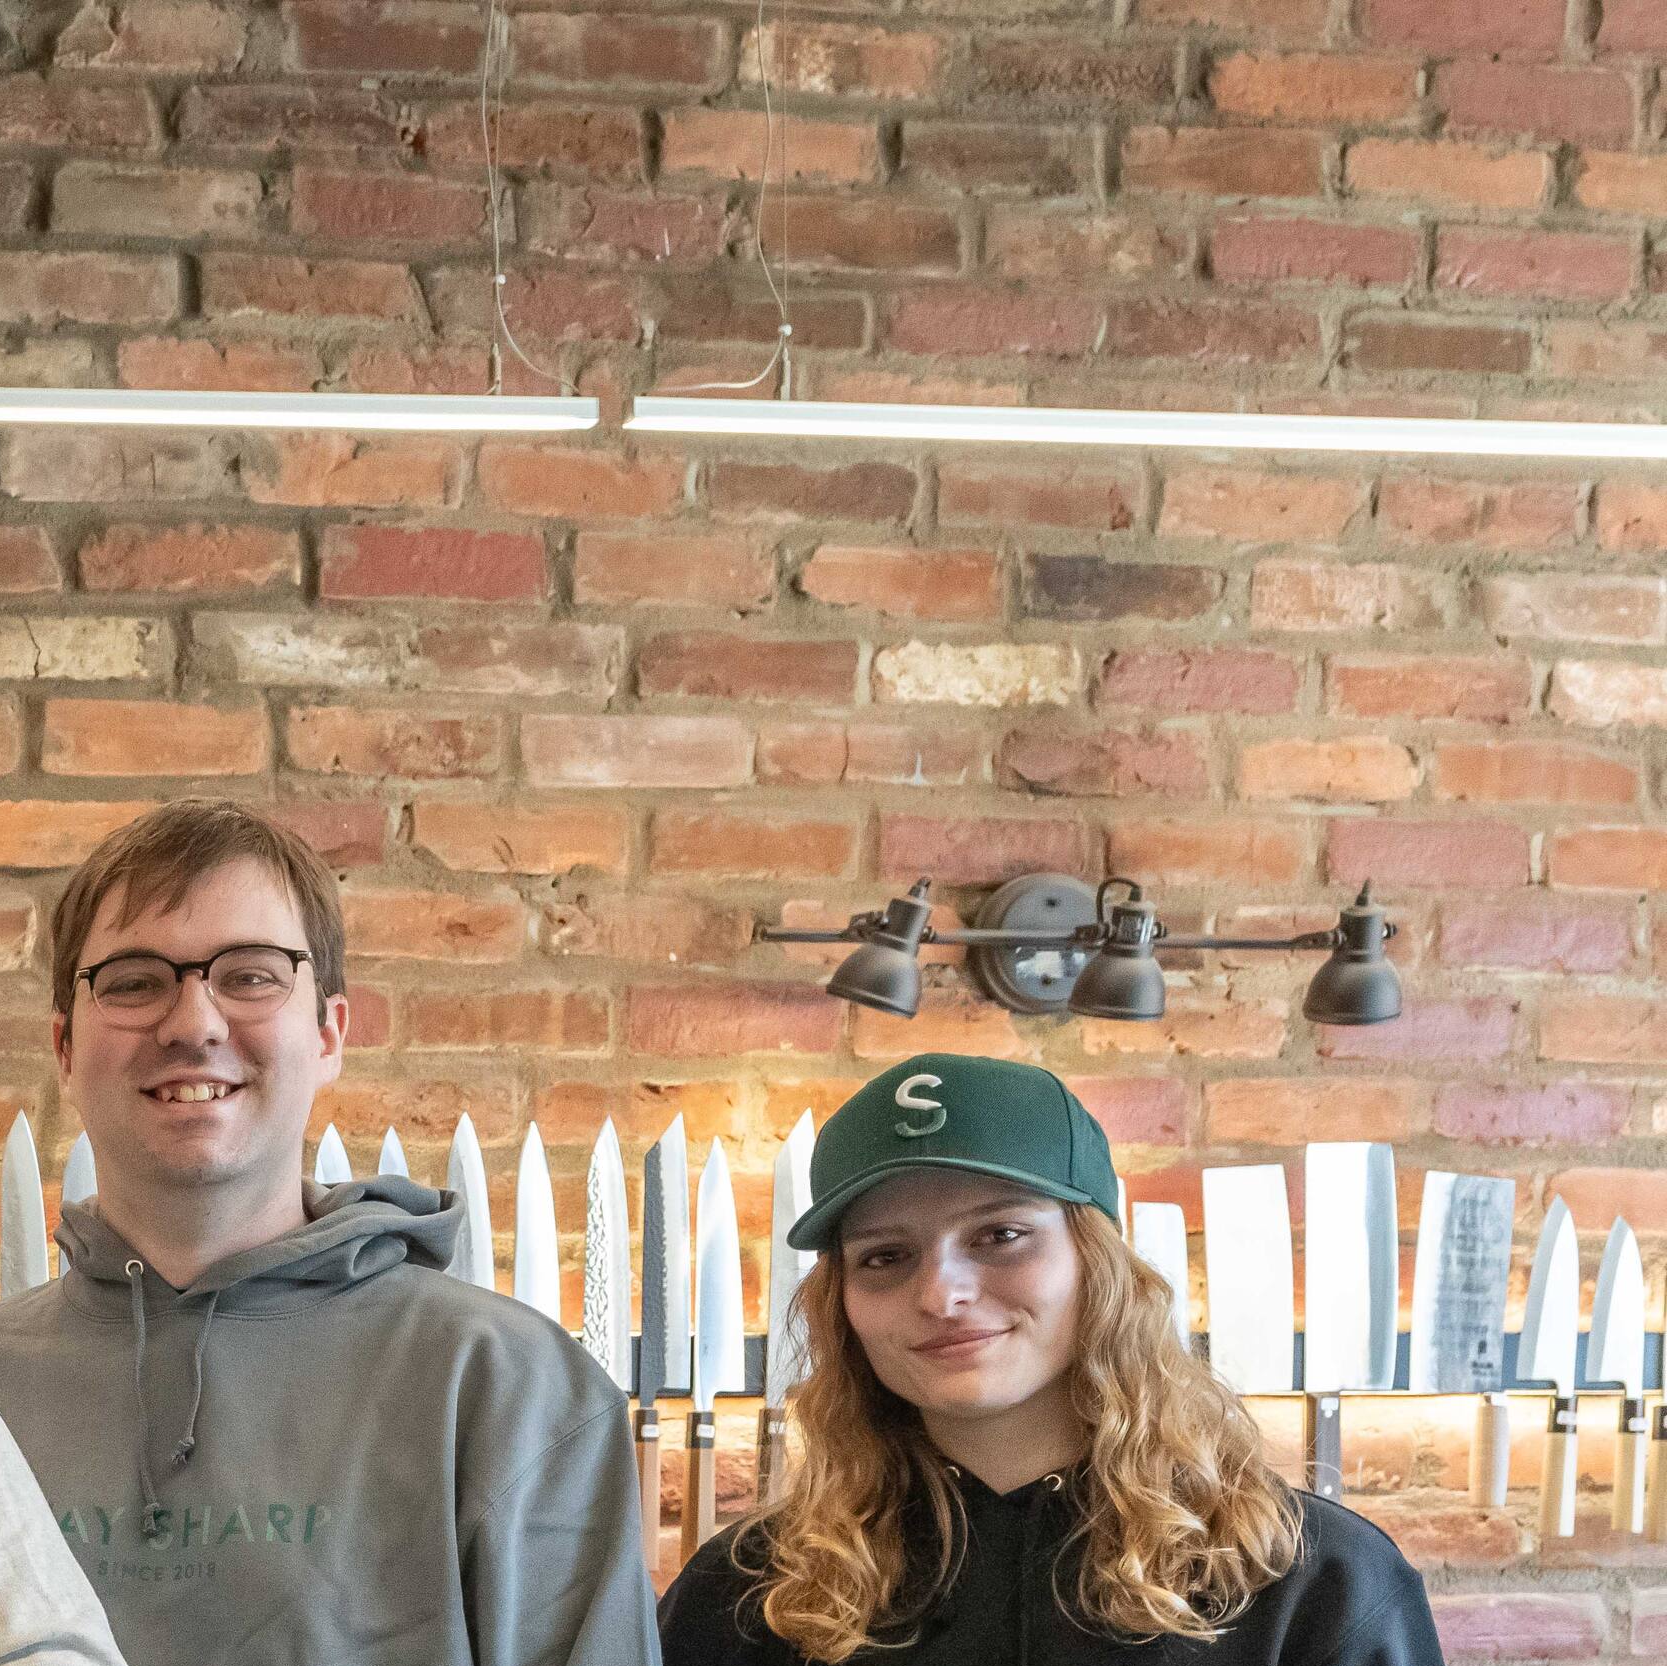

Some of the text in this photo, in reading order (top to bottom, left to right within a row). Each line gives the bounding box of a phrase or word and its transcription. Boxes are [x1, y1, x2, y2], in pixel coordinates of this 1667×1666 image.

[895, 1074, 947, 1137] S
[59, 1505, 124, 1545] AY
[174, 1561, 216, 1580] 2018
